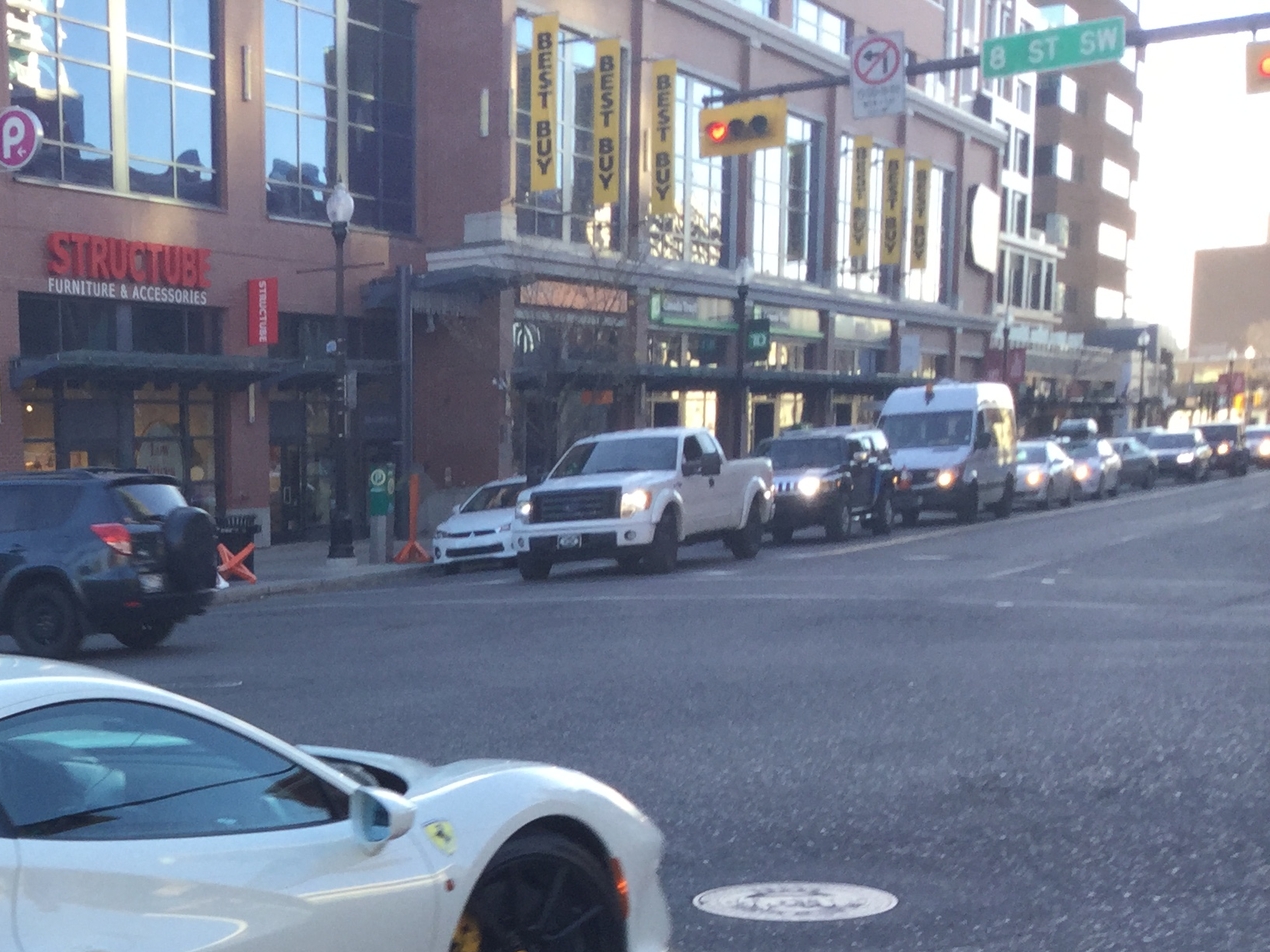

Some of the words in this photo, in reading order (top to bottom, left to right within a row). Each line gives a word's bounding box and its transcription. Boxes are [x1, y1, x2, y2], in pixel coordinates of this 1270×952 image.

[537, 32, 552, 109] BEST
[989, 45, 1006, 70] 8
[1028, 35, 1059, 64] ST
[1081, 27, 1118, 55] SW
[599, 55, 614, 128] BEST
[656, 75, 671, 142] BEST
[536, 120, 552, 175] BUY
[598, 138, 614, 190] BUY
[655, 152, 671, 201] BUY
[46, 231, 212, 288] STRUCTUBE
[48, 277, 116, 299] FURNITURE
[120, 284, 129, 299] &
[132, 285, 208, 306] ACCESSORIES
[258, 280, 268, 343] STRUCTUBE
